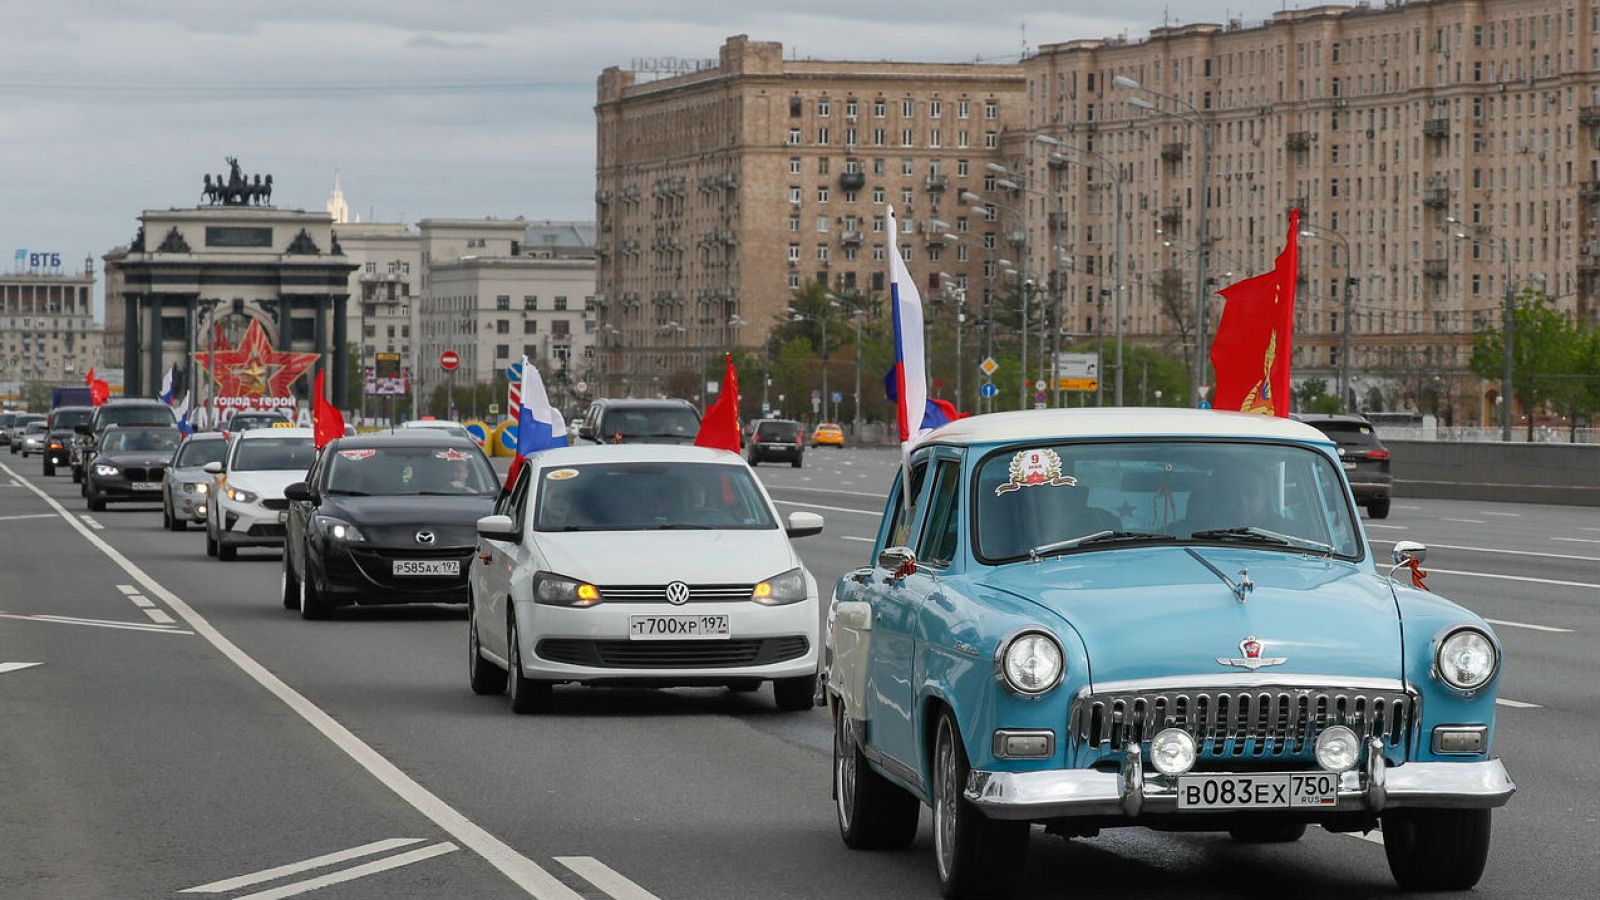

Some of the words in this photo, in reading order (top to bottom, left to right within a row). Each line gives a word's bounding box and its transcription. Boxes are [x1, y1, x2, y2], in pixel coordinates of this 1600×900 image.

[30, 252, 61, 267] ВТБ
[213, 396, 296, 408] город-герой
[1031, 453, 1039, 463] 9
[637, 618, 697, 634] Т700ХР
[701, 616, 724, 629] 197
[1186, 778, 1287, 805] В083ЕХ
[1292, 776, 1330, 796] 750
[1300, 796, 1320, 804] RUS
